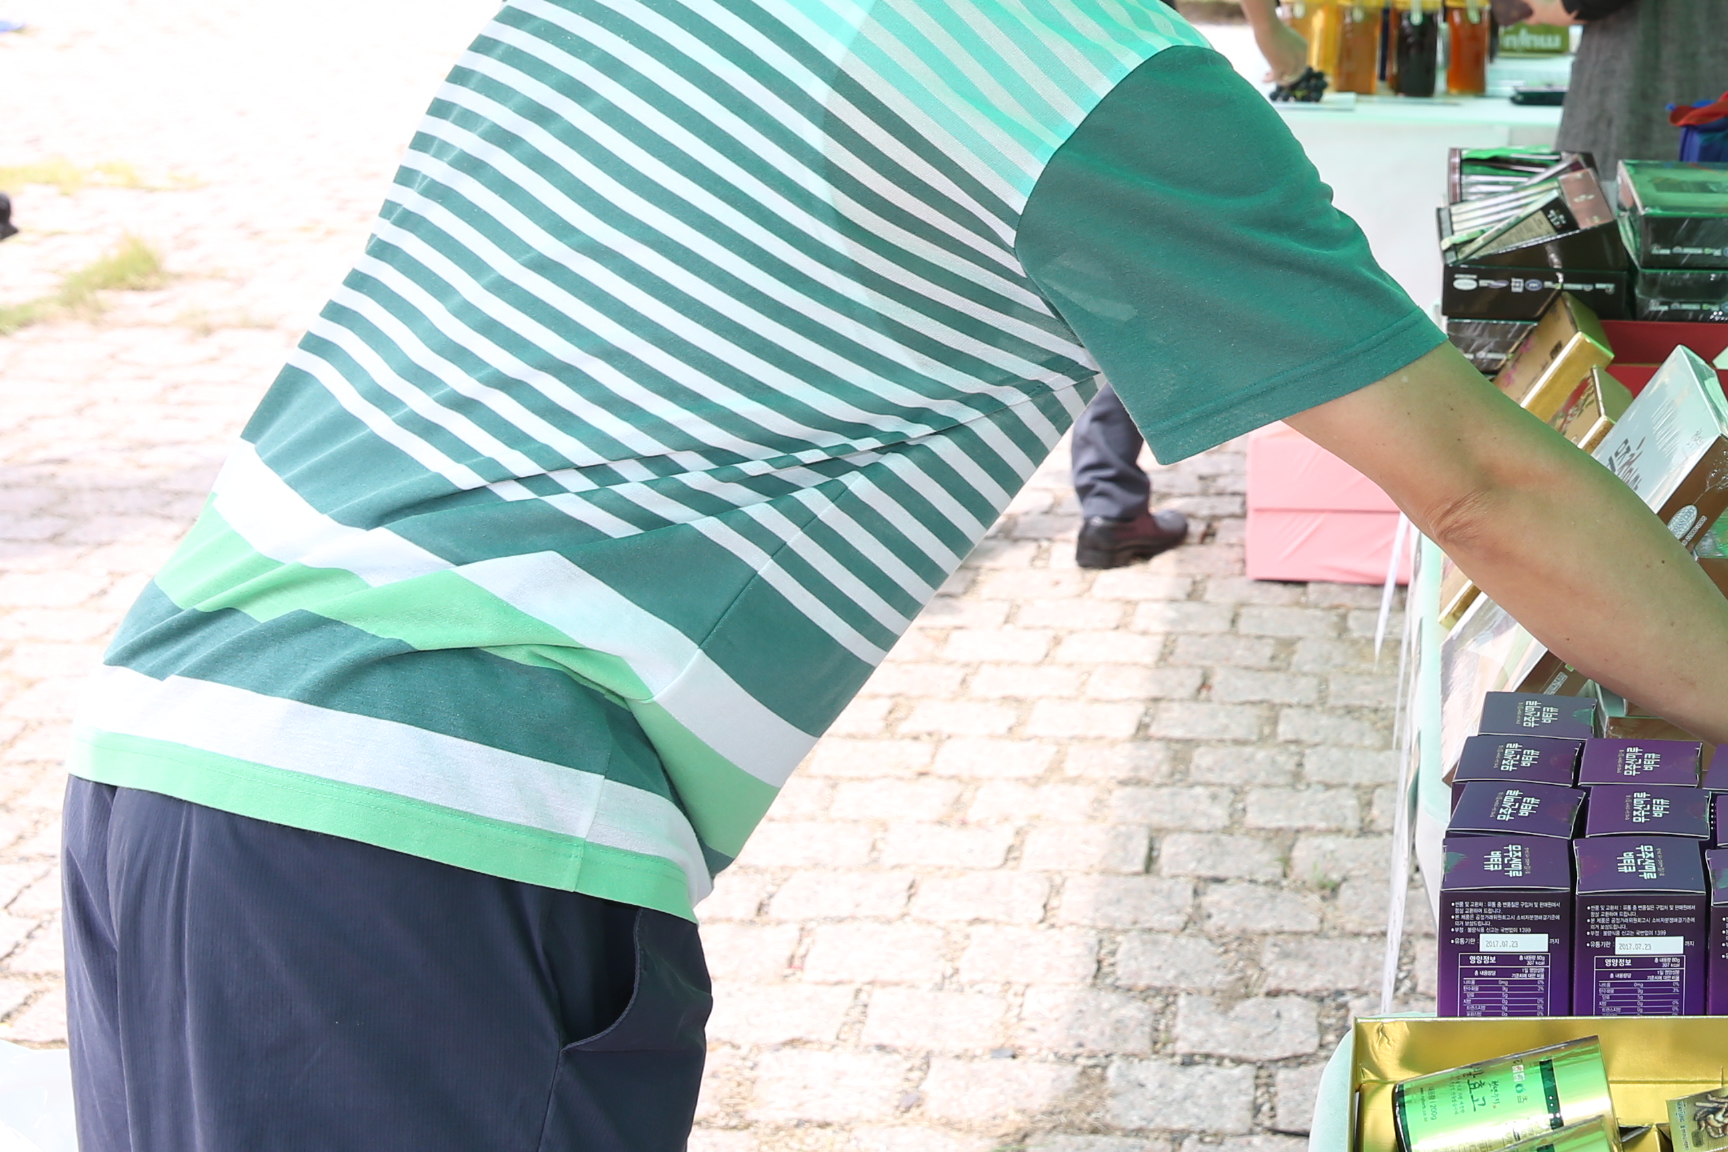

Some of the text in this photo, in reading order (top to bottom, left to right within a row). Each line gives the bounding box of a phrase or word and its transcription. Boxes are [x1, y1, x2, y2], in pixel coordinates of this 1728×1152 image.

[1485, 940, 1519, 948] 2017.07.23
[1618, 943, 1652, 951] 2017.07.23
[1469, 955, 1497, 964] 영양정보
[1604, 957, 1632, 967] 영양정보
